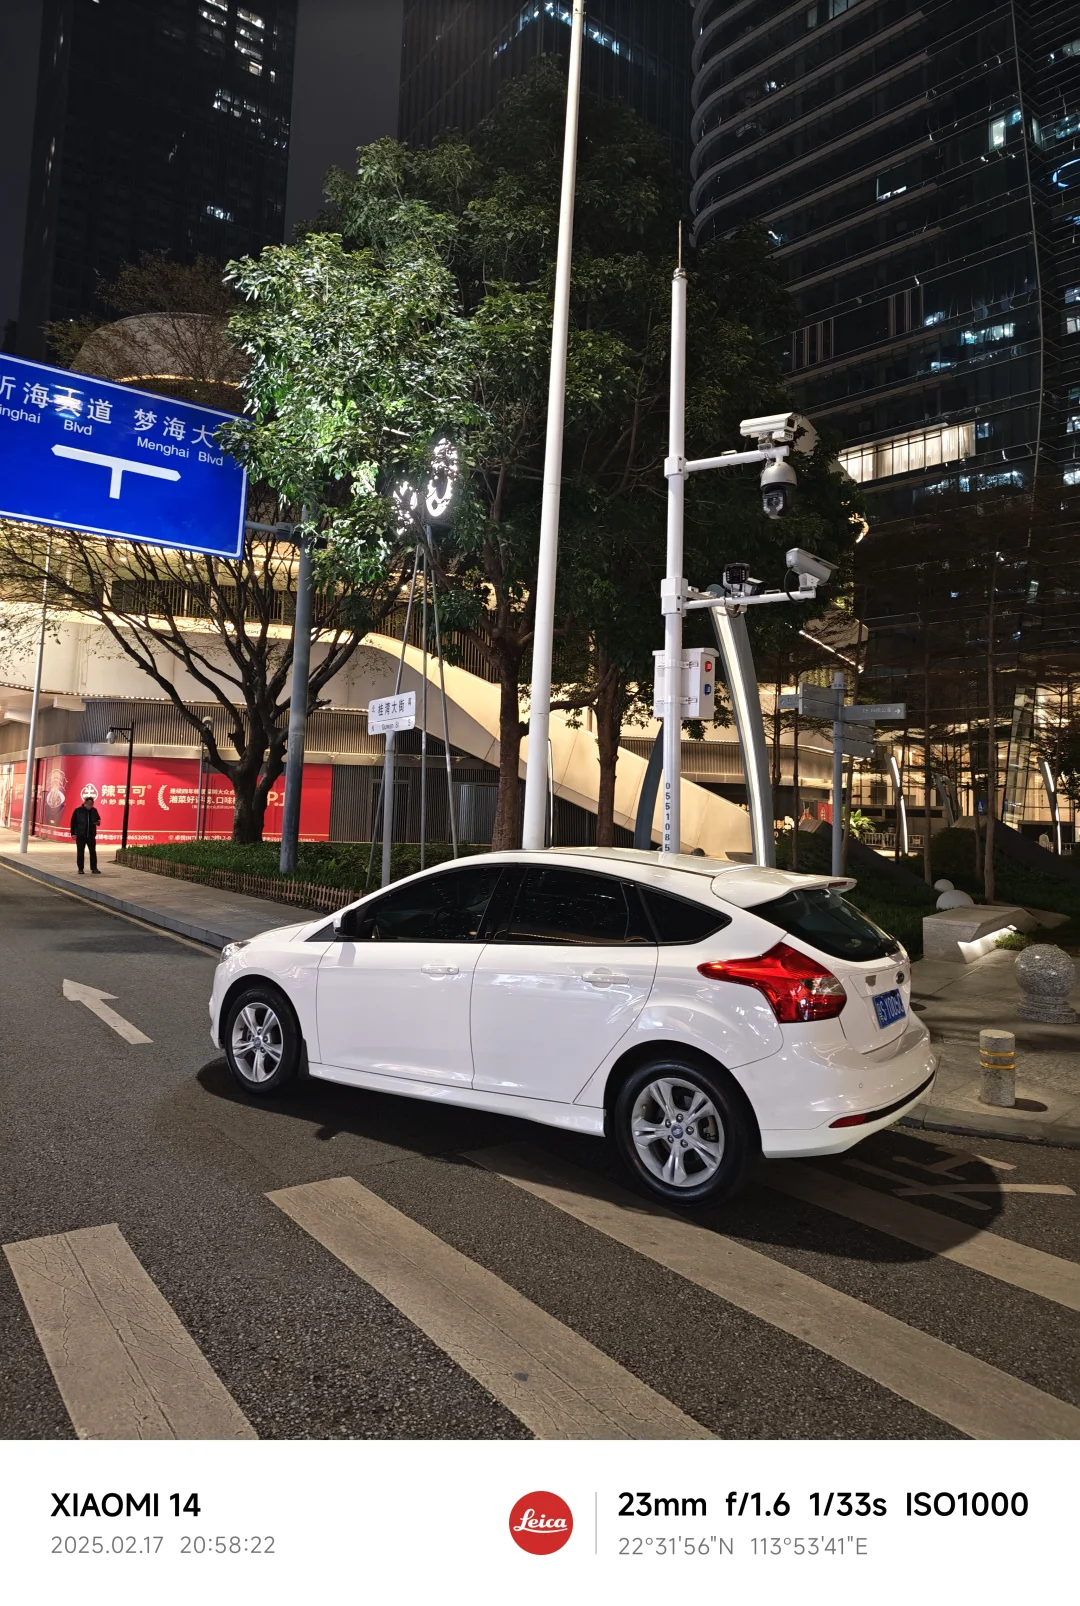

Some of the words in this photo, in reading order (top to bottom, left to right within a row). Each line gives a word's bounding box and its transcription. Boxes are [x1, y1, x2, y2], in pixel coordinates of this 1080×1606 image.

[0, 404, 41, 424] inghai
[63, 419, 93, 436] Blvd
[134, 408, 224, 450] 梦海大
[137, 436, 190, 459] Menghai
[198, 451, 224, 466] Blvd
